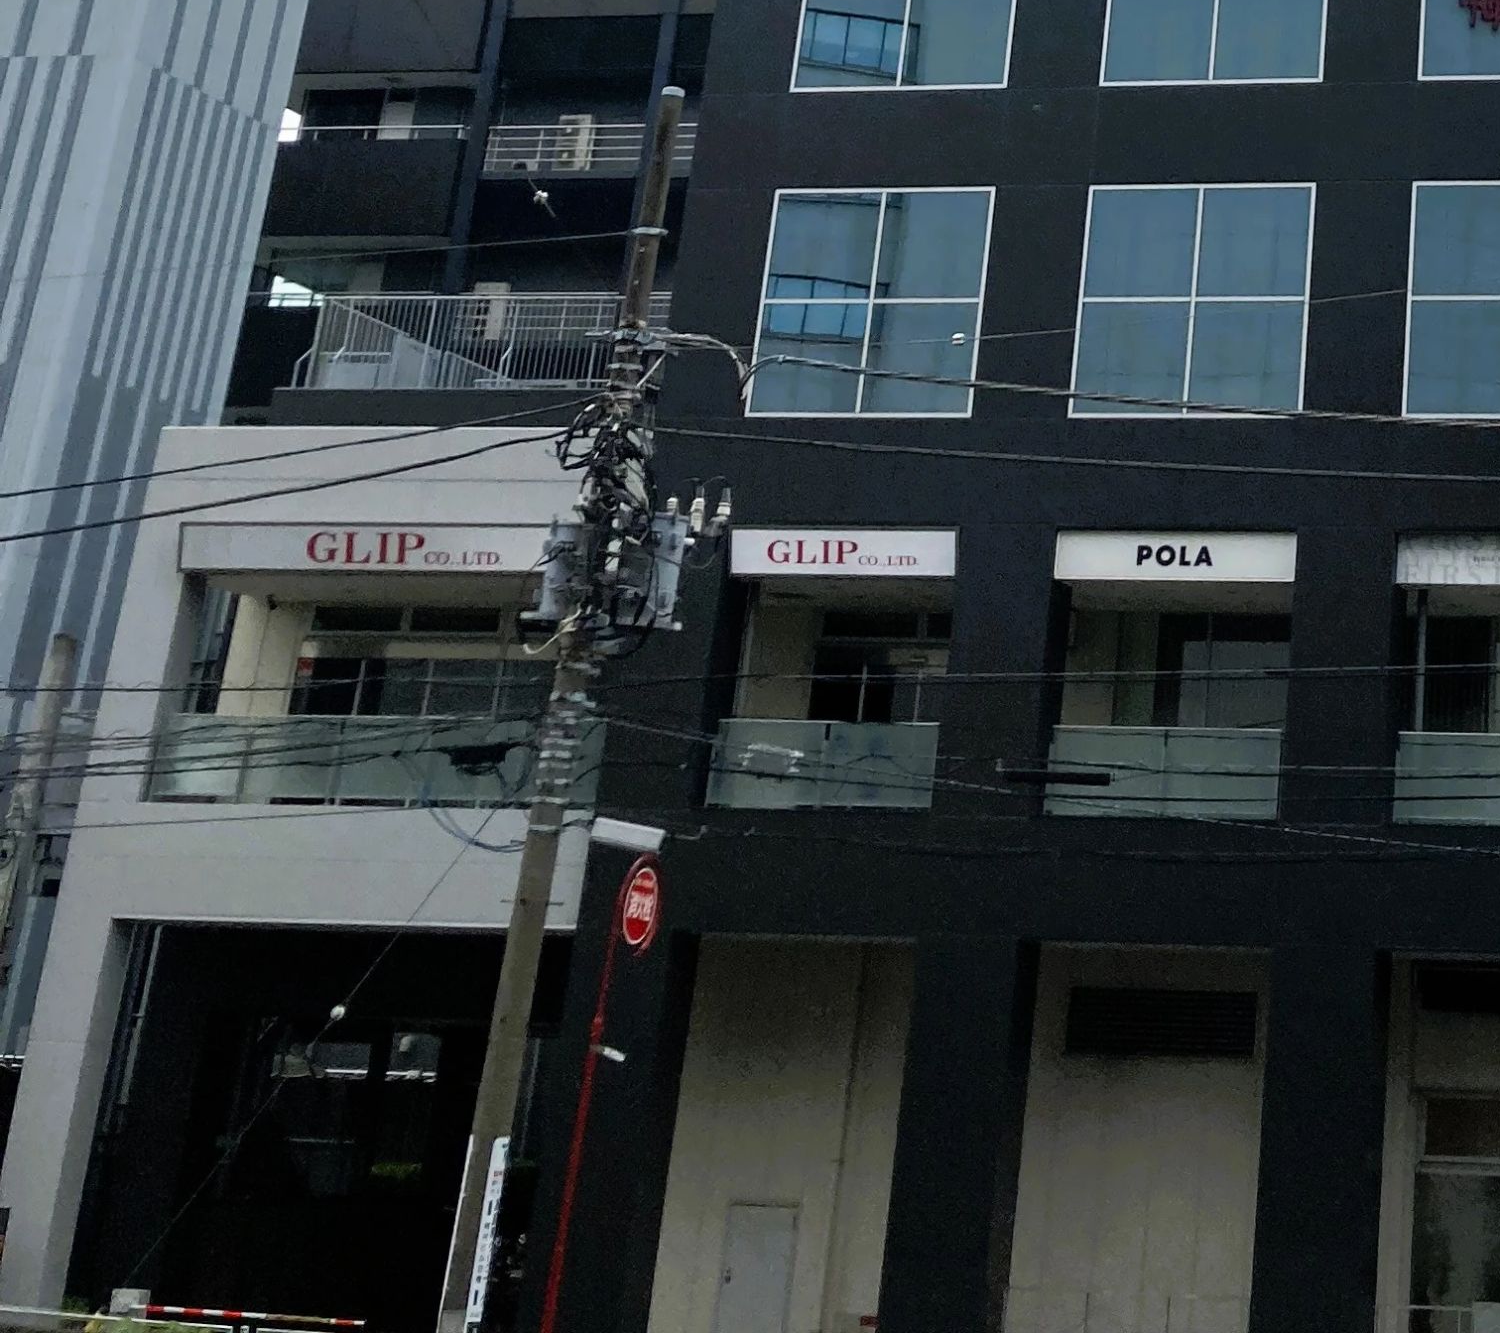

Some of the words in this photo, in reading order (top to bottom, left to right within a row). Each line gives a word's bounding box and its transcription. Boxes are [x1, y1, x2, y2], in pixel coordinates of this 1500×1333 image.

[306, 532, 425, 564] GLIP
[767, 539, 858, 564] GLIP
[1136, 545, 1213, 566] POLA
